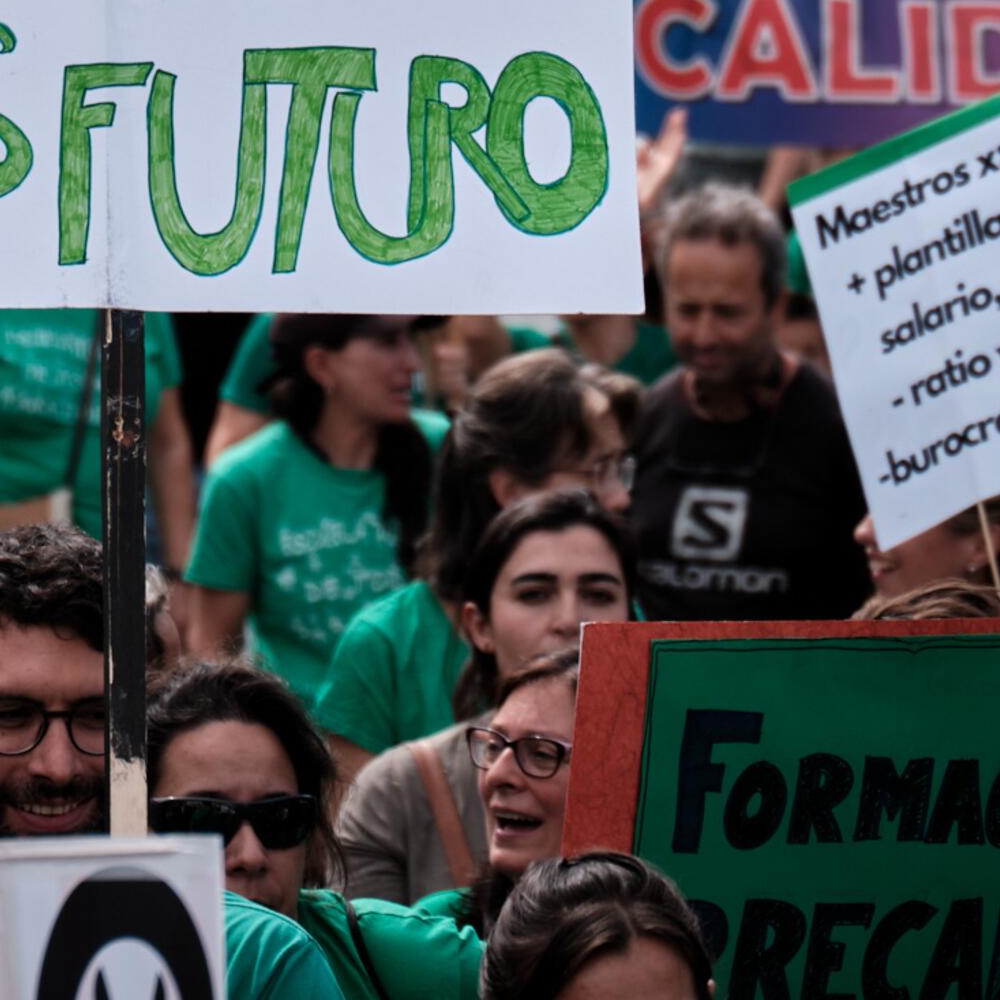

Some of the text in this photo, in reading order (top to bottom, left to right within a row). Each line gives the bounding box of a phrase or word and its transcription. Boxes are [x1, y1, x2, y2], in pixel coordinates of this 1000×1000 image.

[58, 45, 610, 278] FUTURO
[814, 162, 971, 249] Maestros
[910, 349, 993, 407] ratio
[879, 413, 1000, 486] -burocr
[670, 707, 1000, 856] FORMA
[688, 896, 1000, 1000] RECA
